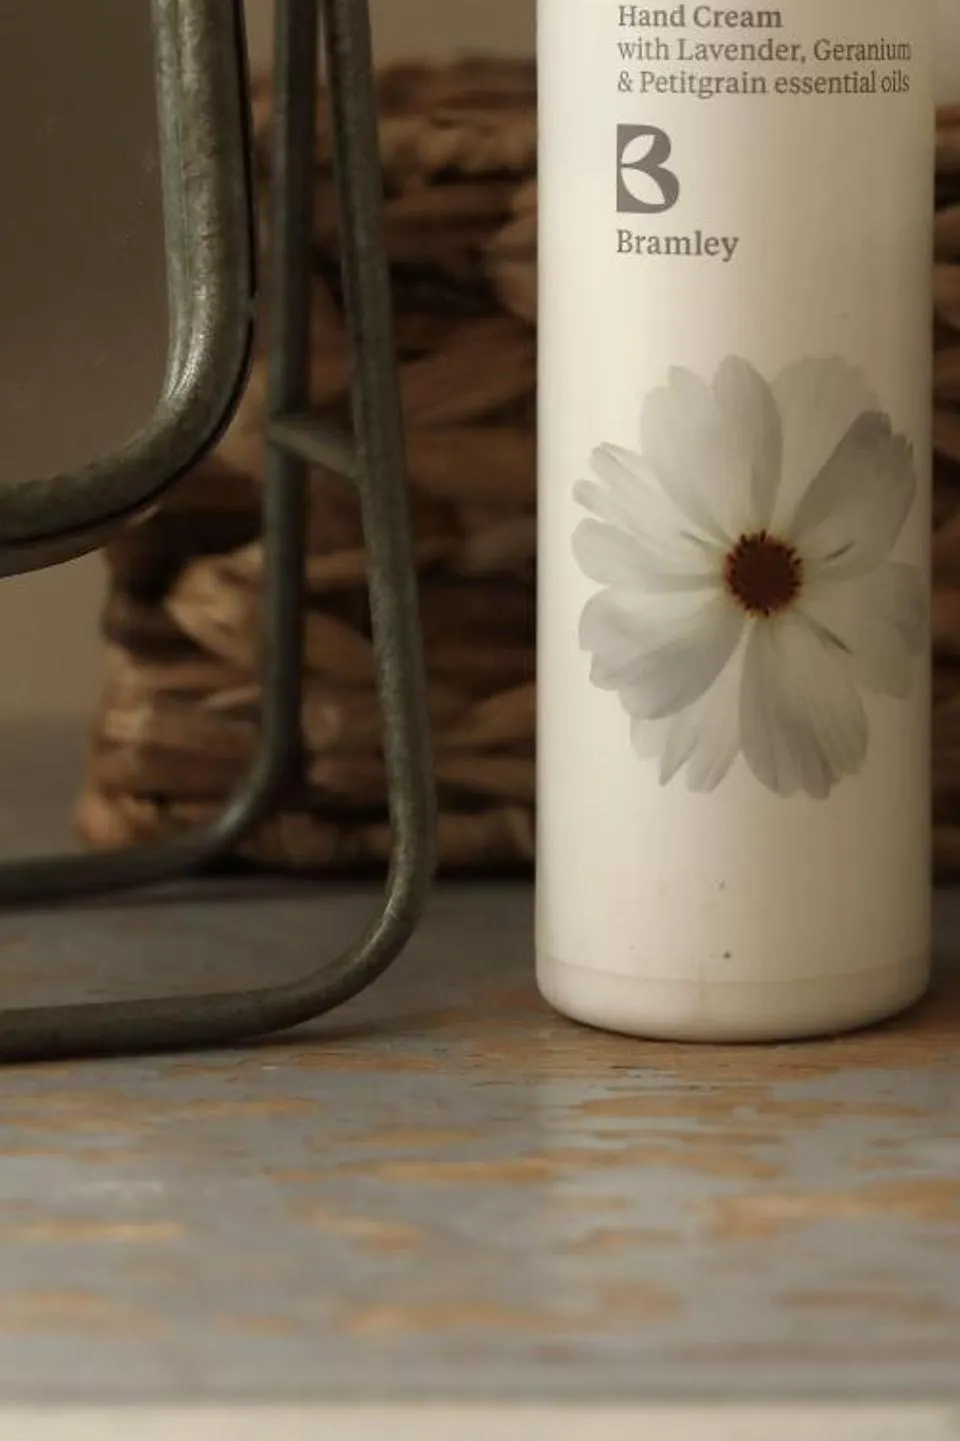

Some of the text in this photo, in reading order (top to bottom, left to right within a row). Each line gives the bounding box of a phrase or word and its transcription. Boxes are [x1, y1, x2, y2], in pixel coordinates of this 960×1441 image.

[617, 4, 784, 29] Hand Cream
[617, 36, 912, 64] with Lavender, Geranium
[617, 69, 911, 99] & Petitgrain essential oils
[616, 228, 740, 262] Bramley
